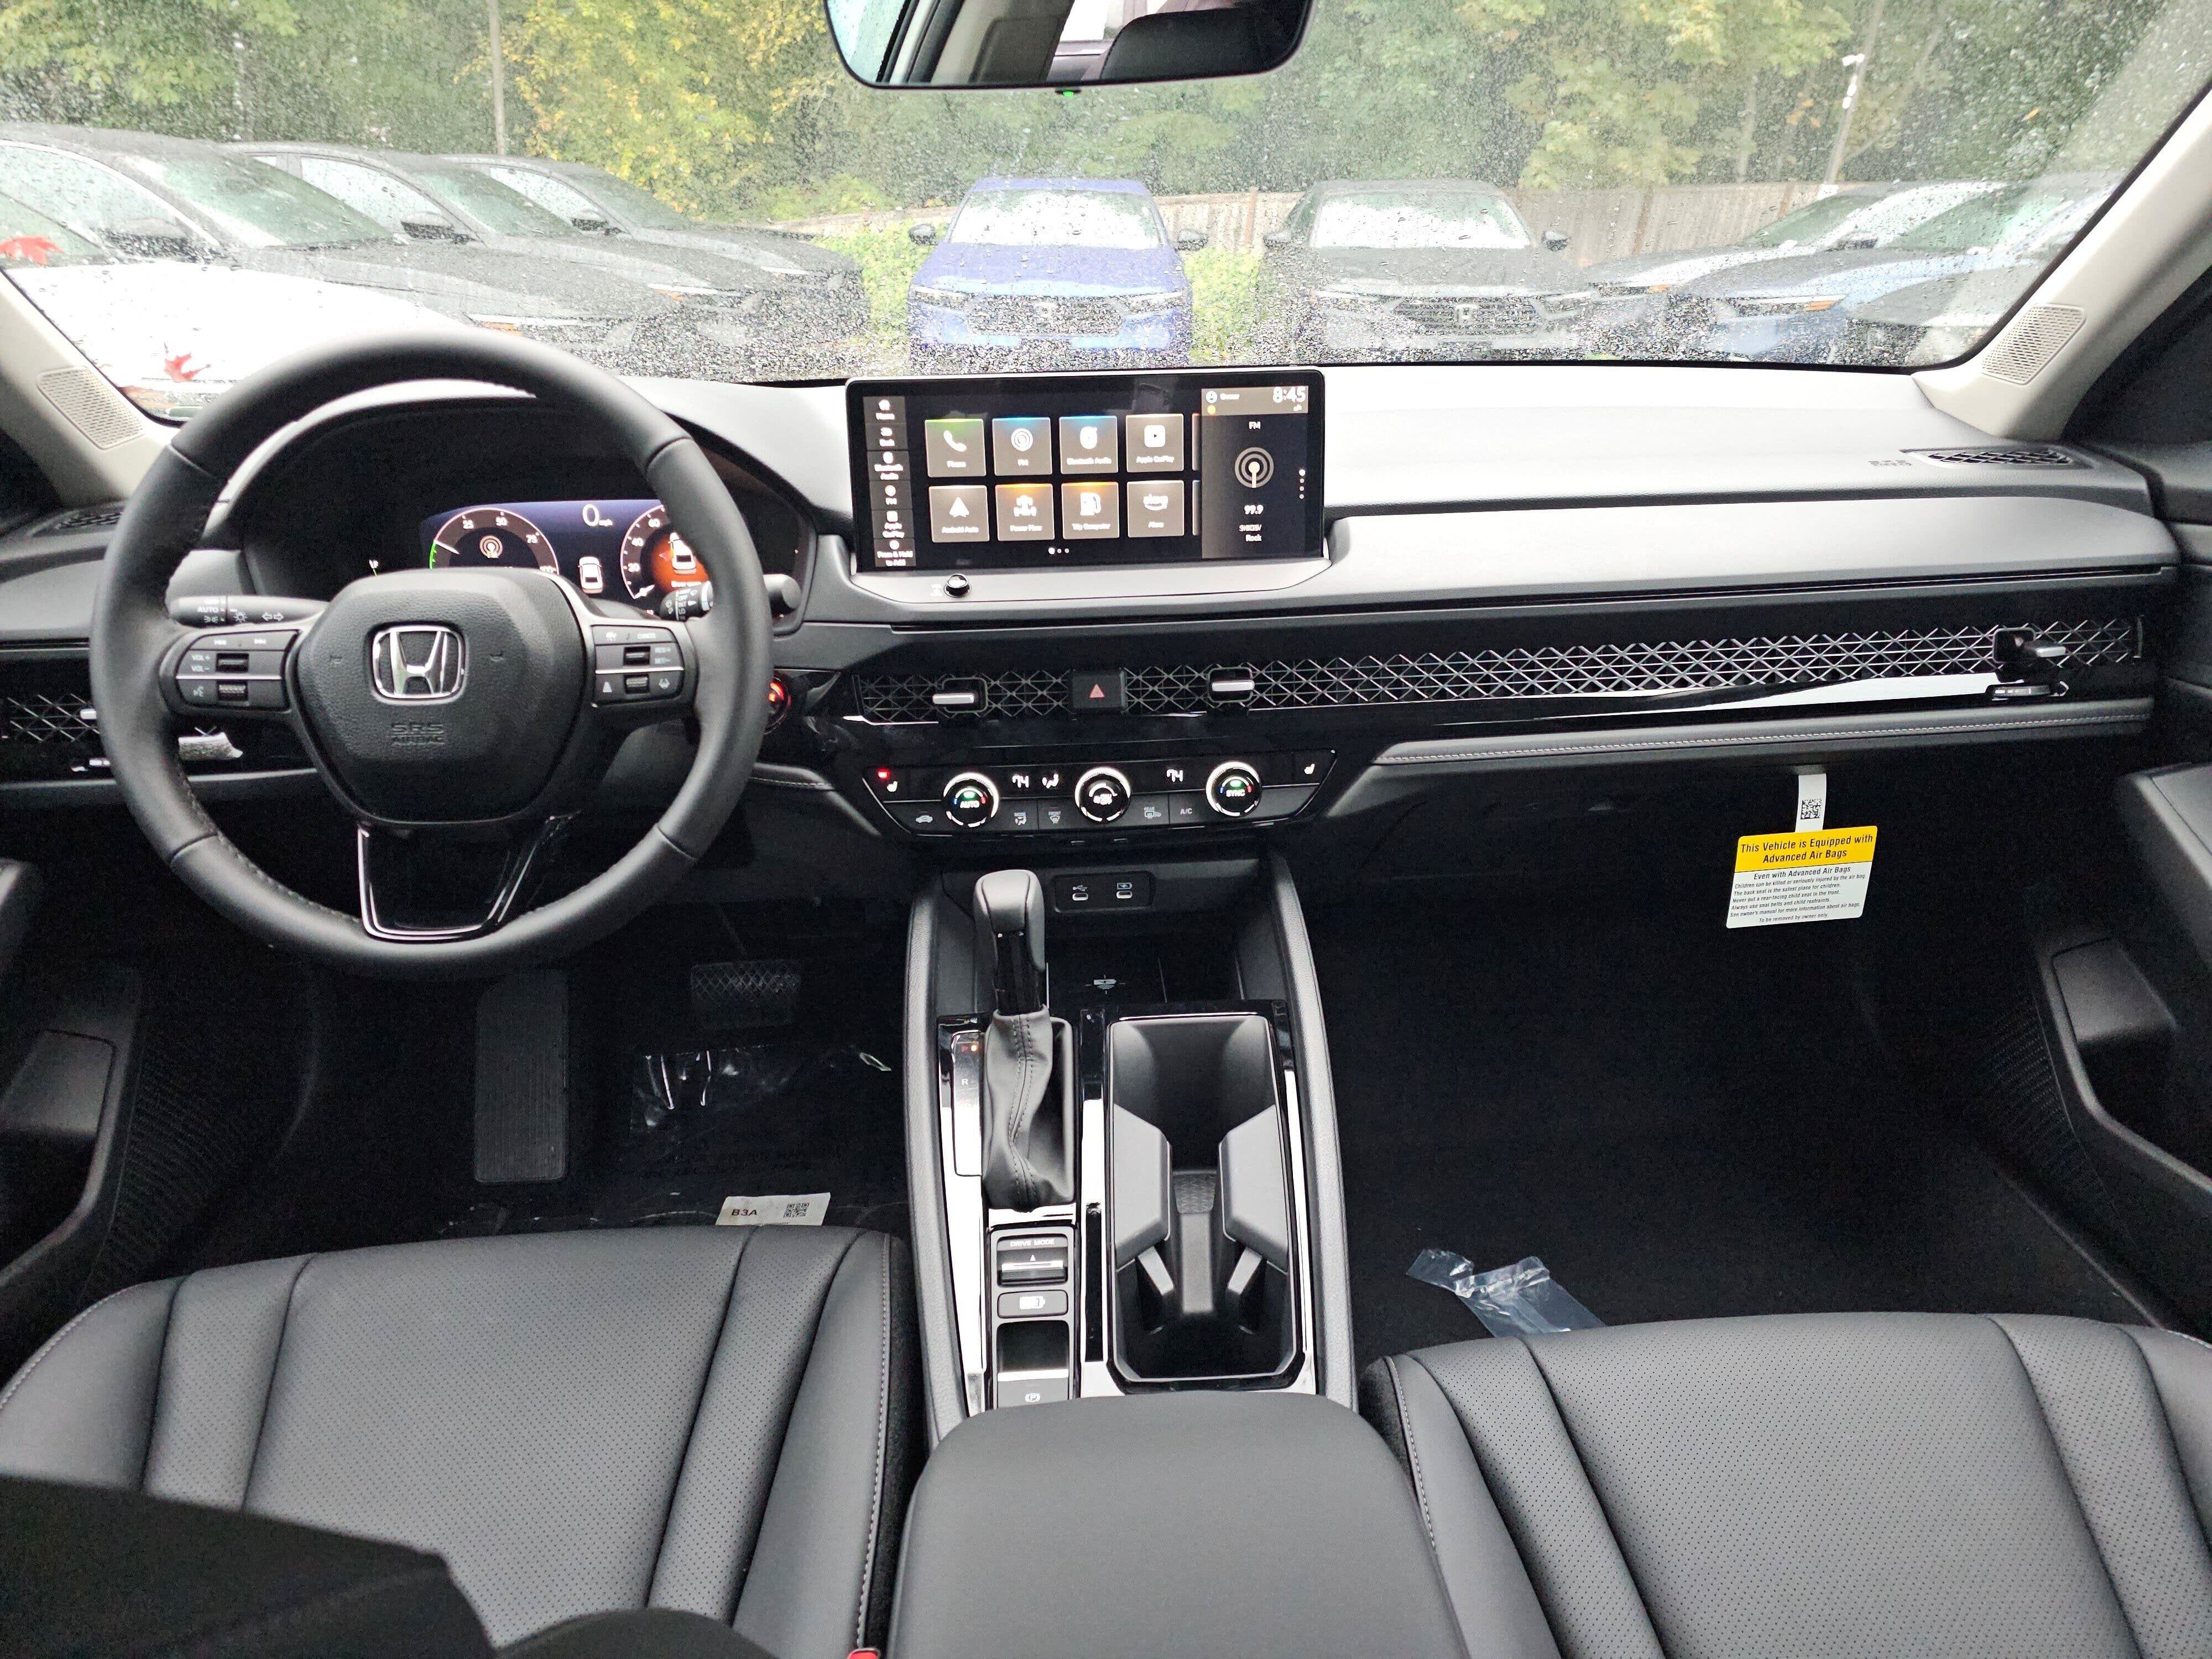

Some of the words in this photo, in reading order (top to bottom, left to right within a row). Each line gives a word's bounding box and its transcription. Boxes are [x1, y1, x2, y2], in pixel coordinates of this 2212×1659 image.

[1273, 387, 1306, 403] 8:45
[1244, 504, 1263, 515] 99.9
[582, 504, 599, 526] 0
[463, 520, 474, 529] 25
[495, 517, 508, 526] 50
[648, 518, 660, 528] 60
[526, 534, 538, 544] 75
[632, 538, 644, 546] 40
[628, 562, 640, 572] 20
[1166, 769, 1183, 782] 74
[1012, 774, 1029, 788] 74
[1226, 789, 1245, 797] SYNC
[959, 800, 980, 808] AUTO
[1741, 843, 1759, 853] This
[1763, 841, 1796, 851] Vehicle
[1799, 839, 1807, 848] is
[1810, 836, 1851, 848] Equipped
[1855, 834, 1873, 843] with
[1763, 852, 1807, 863] Advanced
[1809, 851, 1823, 859] Air
[1825, 849, 1847, 859] Bags
[1788, 869, 1821, 877] Advanced
